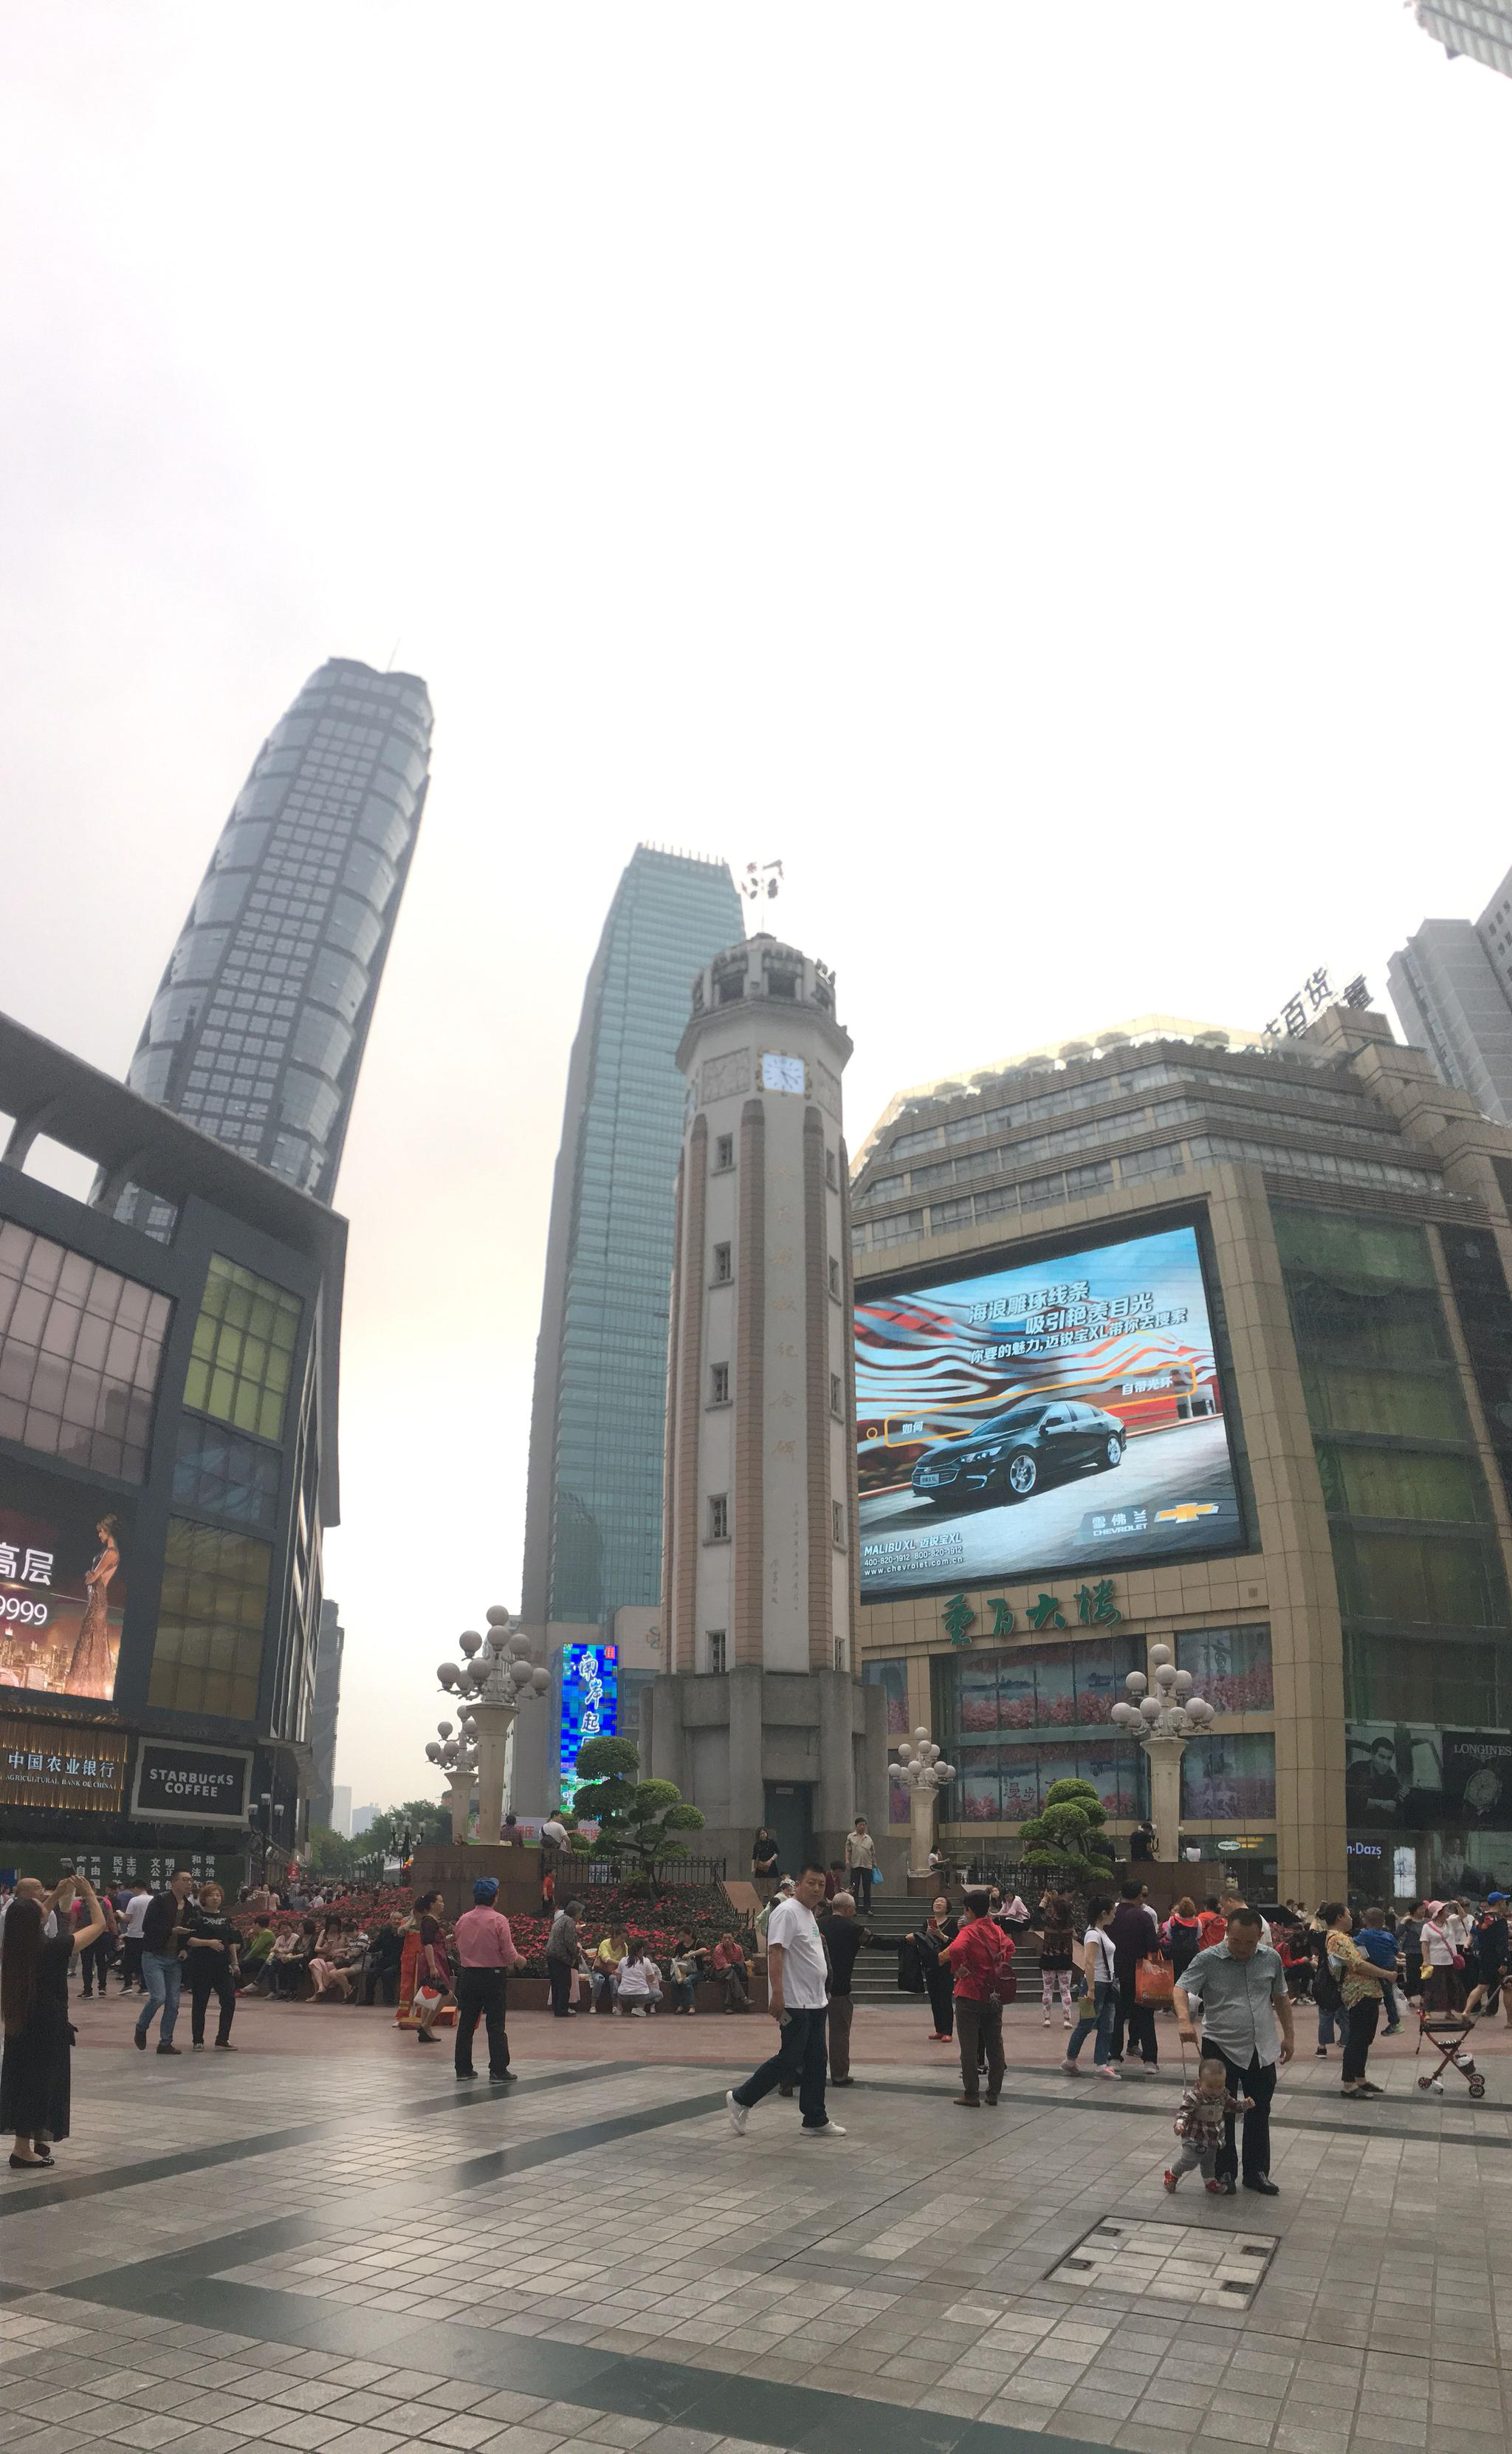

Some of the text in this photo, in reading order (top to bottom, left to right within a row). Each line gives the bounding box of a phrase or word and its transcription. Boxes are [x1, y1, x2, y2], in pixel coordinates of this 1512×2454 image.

[1025, 1292, 1152, 1335] 吸引艳羡目光
[1092, 1509, 1147, 1529] 雪佛兰
[1093, 1523, 1148, 1537] CHEVROLET
[864, 1546, 962, 1566] 400-820-1912 800-820-1912
[865, 1557, 963, 1576] www.chevrolet.com.cn
[579, 1651, 603, 1747] 南岸起
[1454, 1744, 1512, 1757] LONGINES
[8, 1751, 114, 1778] 中国农业银行
[5, 1774, 59, 1784] AGRICULTURAL
[61, 1778, 80, 1786] BANK
[93, 1781, 113, 1789] CHINA
[150, 1769, 234, 1786] STARBUCKS
[165, 1782, 218, 1797] COFFEE
[112, 1857, 137, 1867] 民主
[151, 1857, 175, 1868] 文明
[191, 1855, 215, 1865] 和谐
[76, 1865, 100, 1876] 自由
[112, 1866, 137, 1877] 平等
[191, 1868, 215, 1877] 法治
